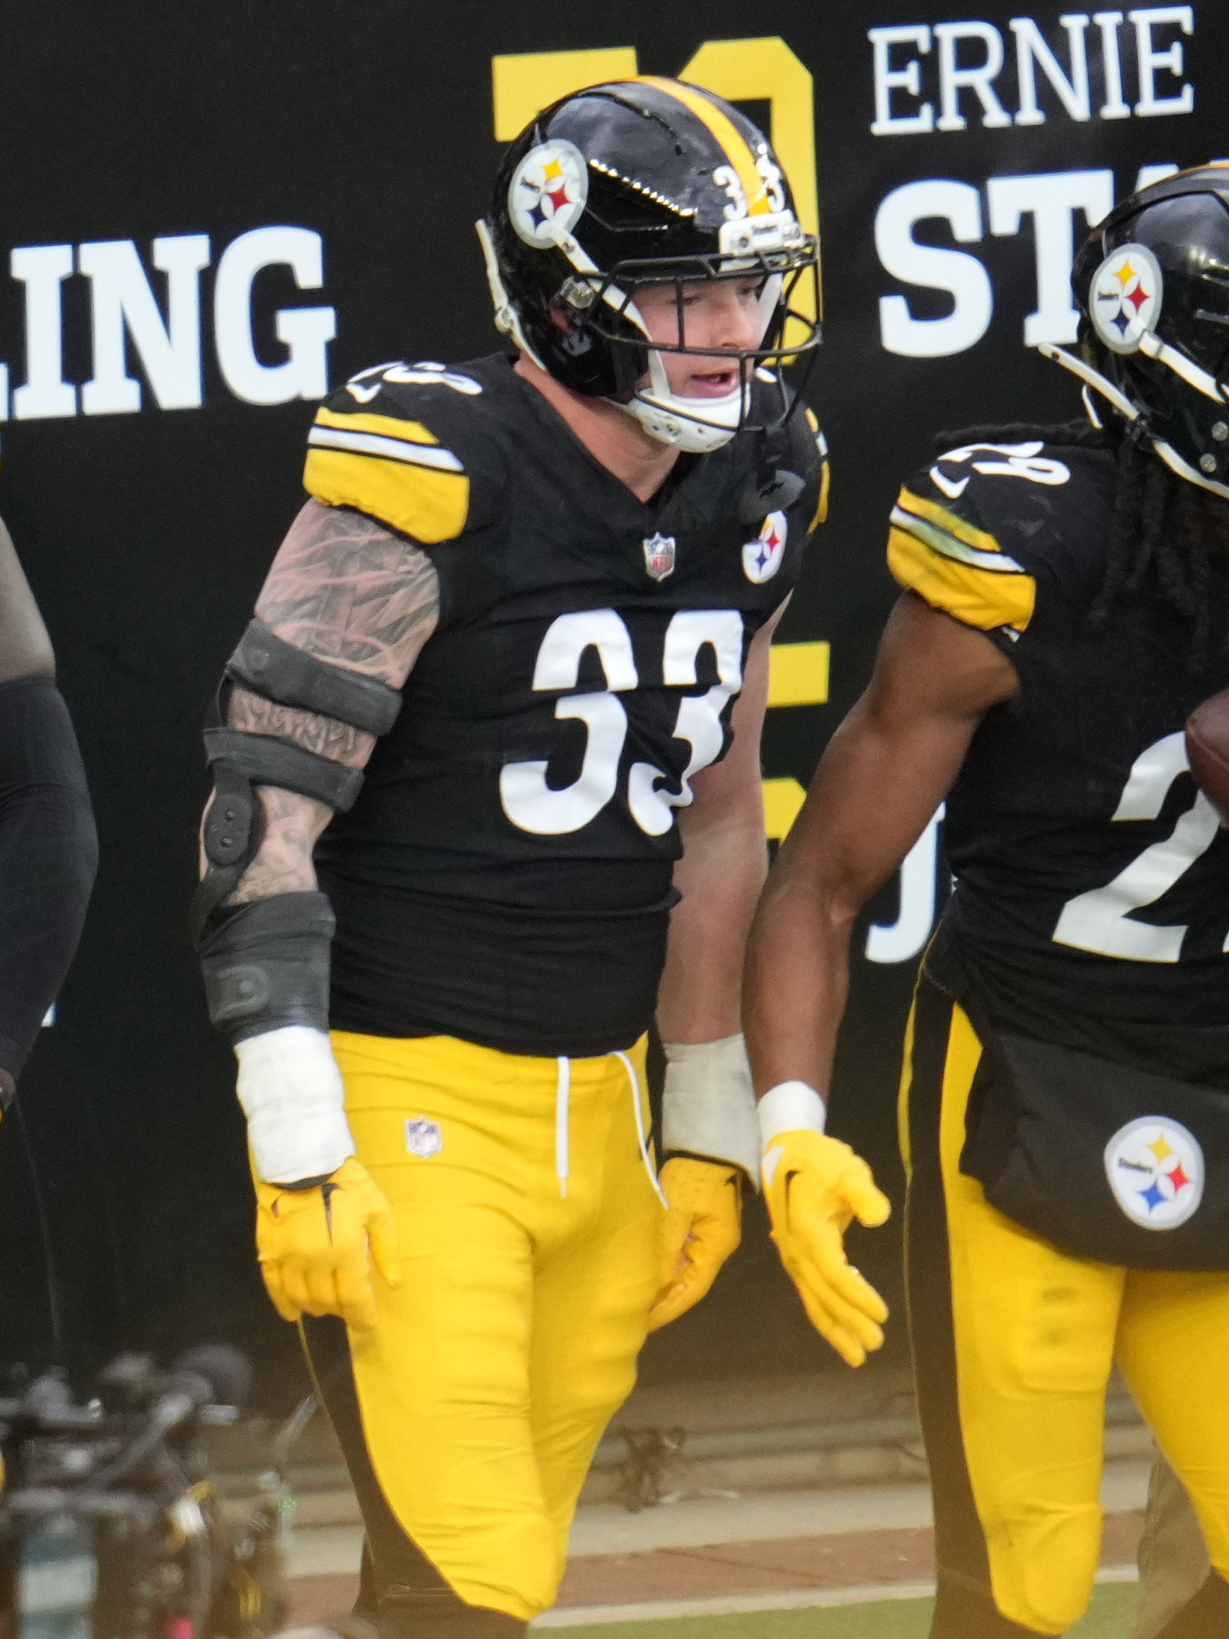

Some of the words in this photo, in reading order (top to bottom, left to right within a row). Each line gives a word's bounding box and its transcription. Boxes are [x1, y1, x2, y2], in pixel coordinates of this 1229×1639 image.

[867, 6, 1195, 136] ERNIE
[0, 226, 336, 420] ING
[500, 609, 743, 836] 33
